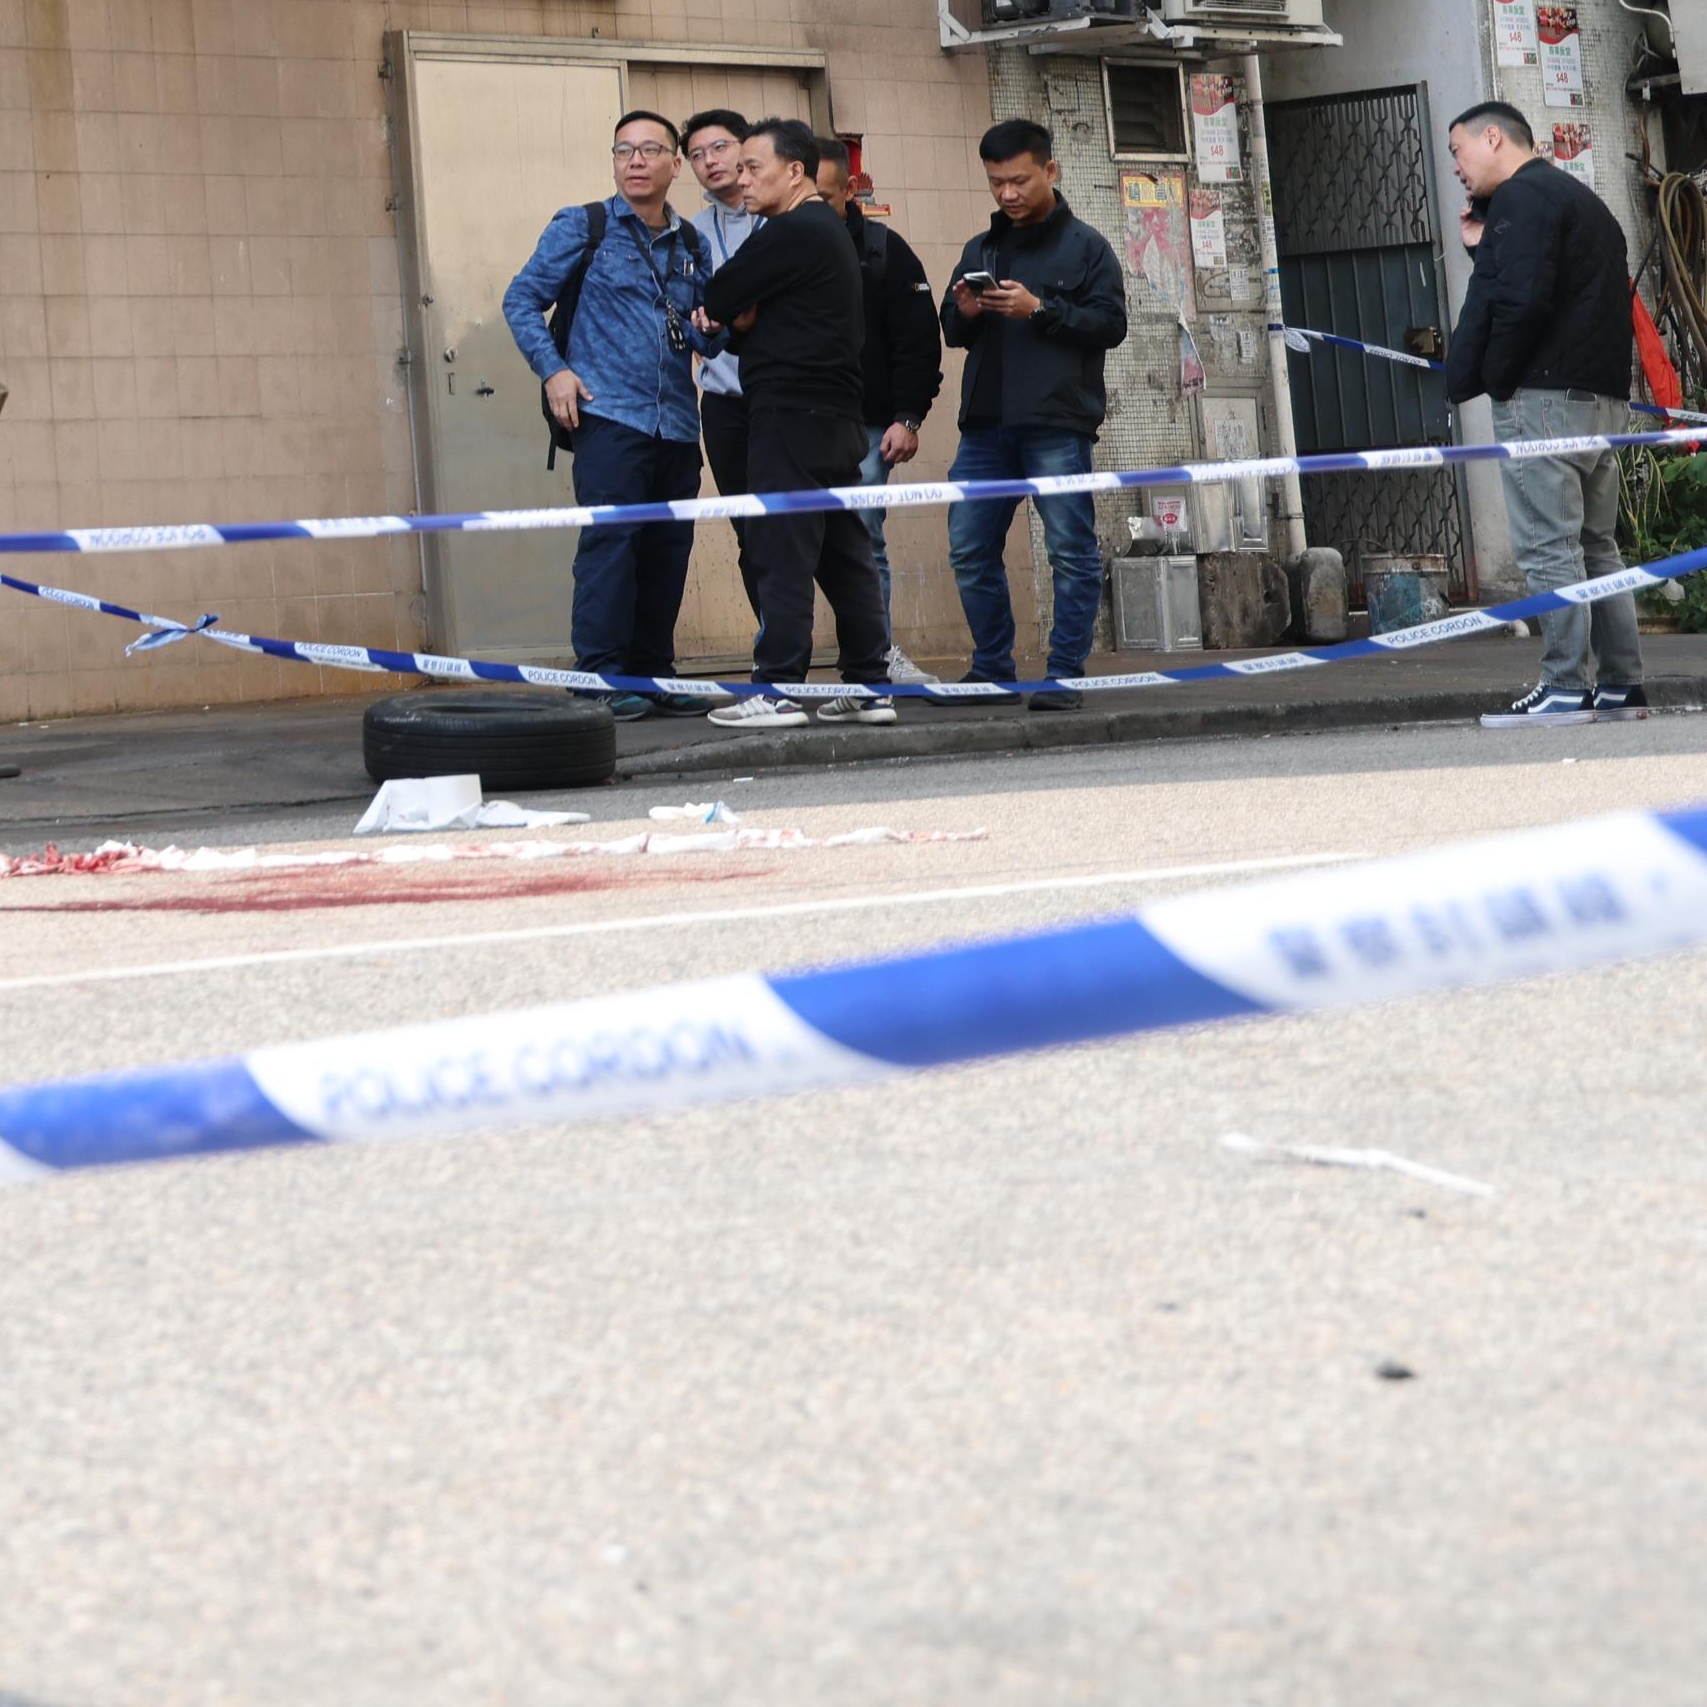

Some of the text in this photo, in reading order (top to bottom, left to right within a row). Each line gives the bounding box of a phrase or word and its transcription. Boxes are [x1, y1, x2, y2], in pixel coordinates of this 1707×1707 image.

[1210, 145, 1224, 157] $48
[1387, 615, 1482, 645] POLICE CORDON
[528, 670, 597, 686] POLICE CORDON
[1109, 674, 1157, 687] CORDON
[320, 1020, 757, 1122] POLICE CORDON
